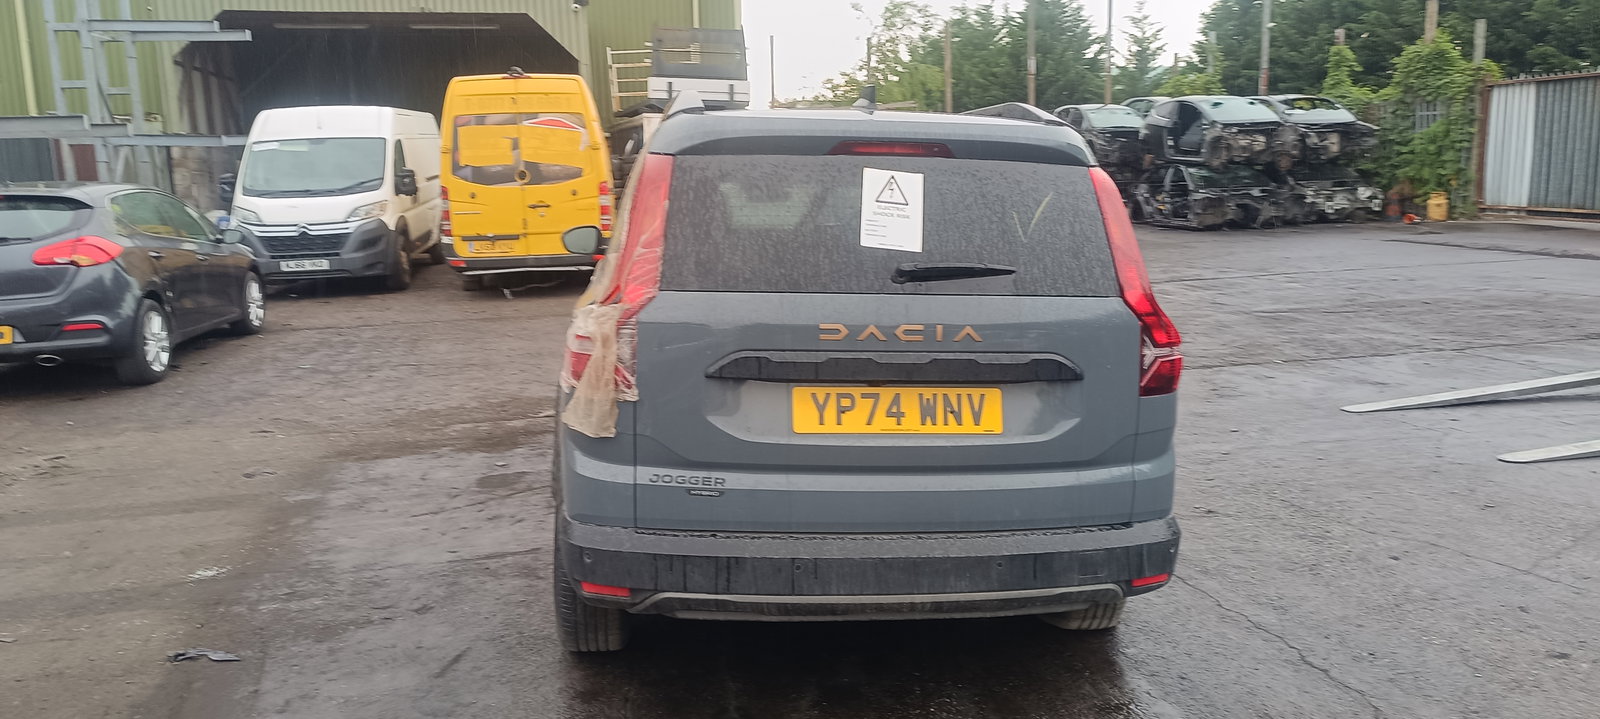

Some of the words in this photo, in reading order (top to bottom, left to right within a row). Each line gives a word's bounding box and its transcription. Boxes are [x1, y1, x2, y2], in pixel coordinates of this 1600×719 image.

[818, 323, 983, 342] DACIA
[811, 392, 905, 425] YP74
[918, 392, 985, 426] WNV
[649, 474, 726, 487] JOGGER
